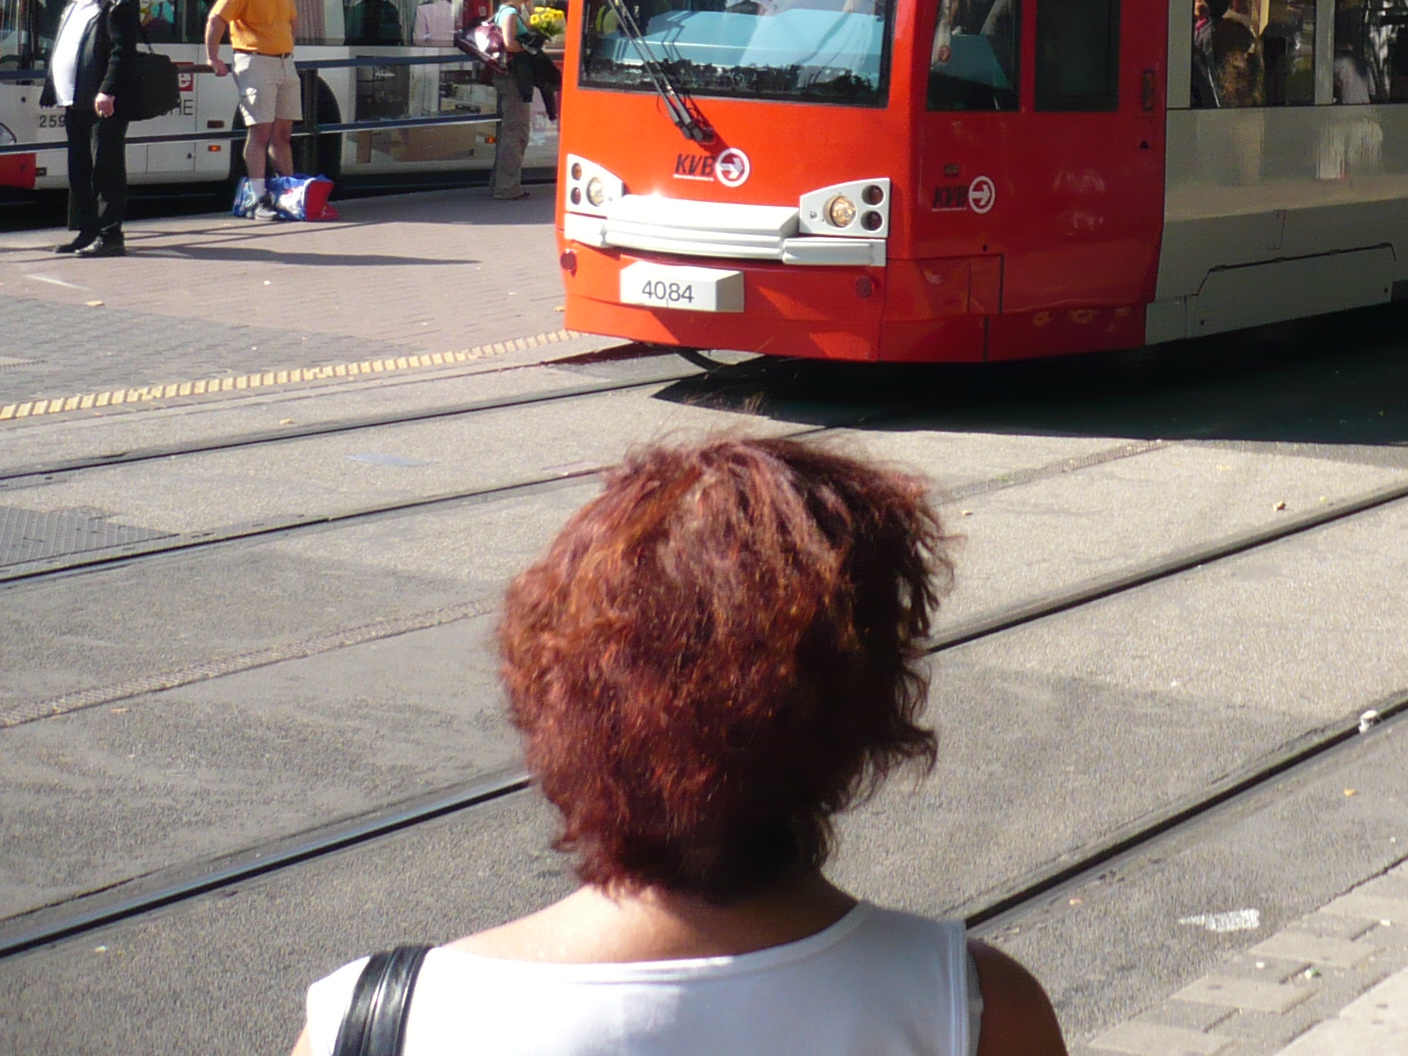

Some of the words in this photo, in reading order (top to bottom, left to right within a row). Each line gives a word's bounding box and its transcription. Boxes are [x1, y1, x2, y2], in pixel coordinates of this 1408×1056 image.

[674, 153, 716, 176] KVB
[933, 186, 969, 208] KVB
[642, 280, 695, 304] 4084
